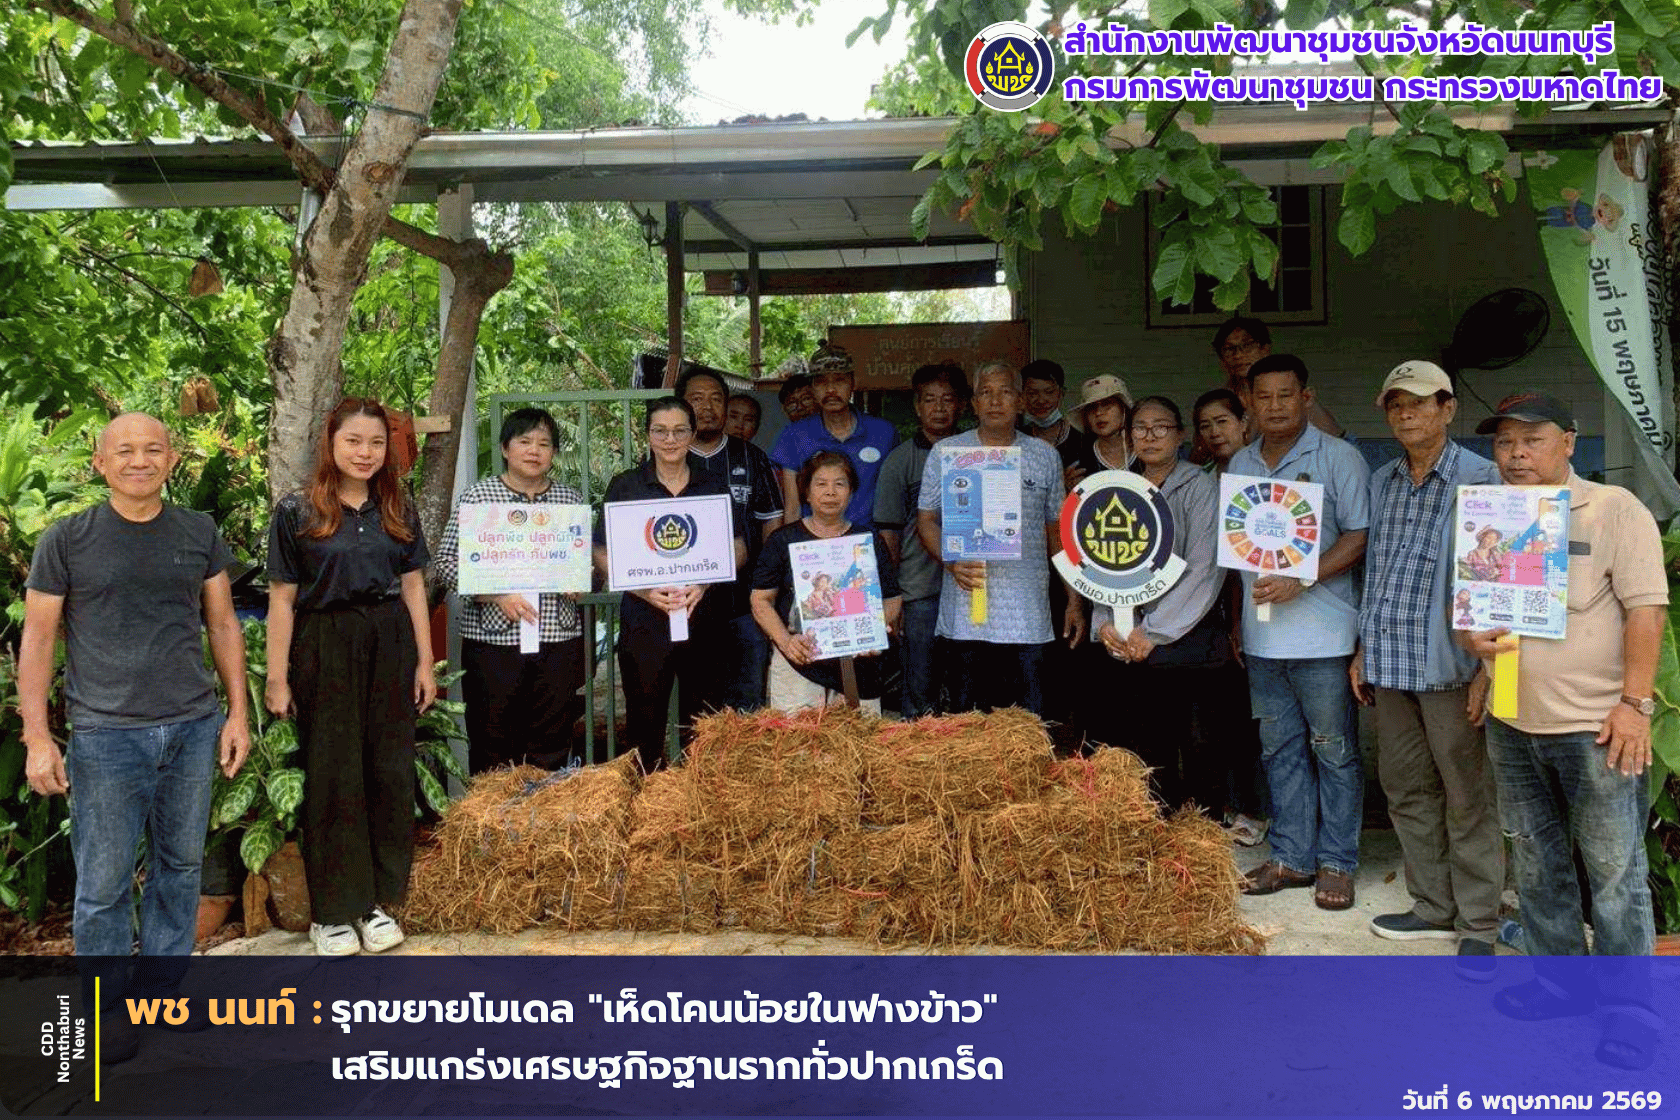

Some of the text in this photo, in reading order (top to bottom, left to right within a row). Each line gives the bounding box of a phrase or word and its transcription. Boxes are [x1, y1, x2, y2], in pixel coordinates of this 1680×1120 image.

[1588, 257, 1628, 301] วันที่
[1603, 307, 1628, 333] 15
[1074, 578, 1167, 605] สพอ.ปากเกร็ด
